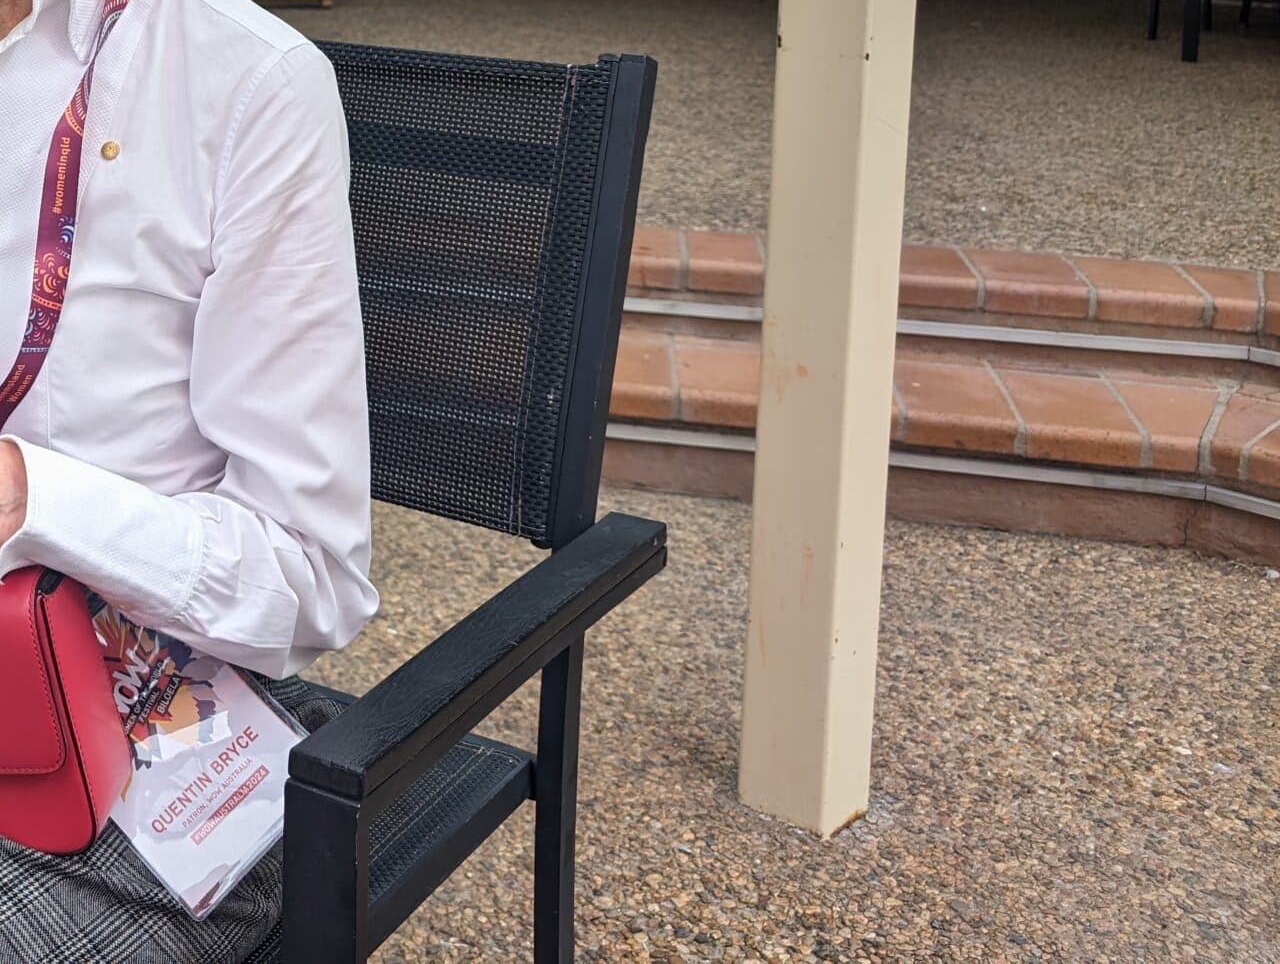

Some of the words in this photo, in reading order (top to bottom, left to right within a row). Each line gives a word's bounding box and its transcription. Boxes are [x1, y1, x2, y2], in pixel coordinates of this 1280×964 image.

[52, 137, 71, 213] #womeninqld
[6, 374, 33, 402] Women
[139, 691, 160, 722] FESTIVAL
[157, 677, 180, 713] BILOELA
[152, 772, 212, 833] QUENTIN
[210, 726, 259, 775] BRYCE
[183, 802, 208, 828] PATRON,
[207, 787, 224, 804] WOW
[222, 758, 253, 789] AUSTRALIA
[195, 768, 266, 842] #WOWAUSTRALIA2024
